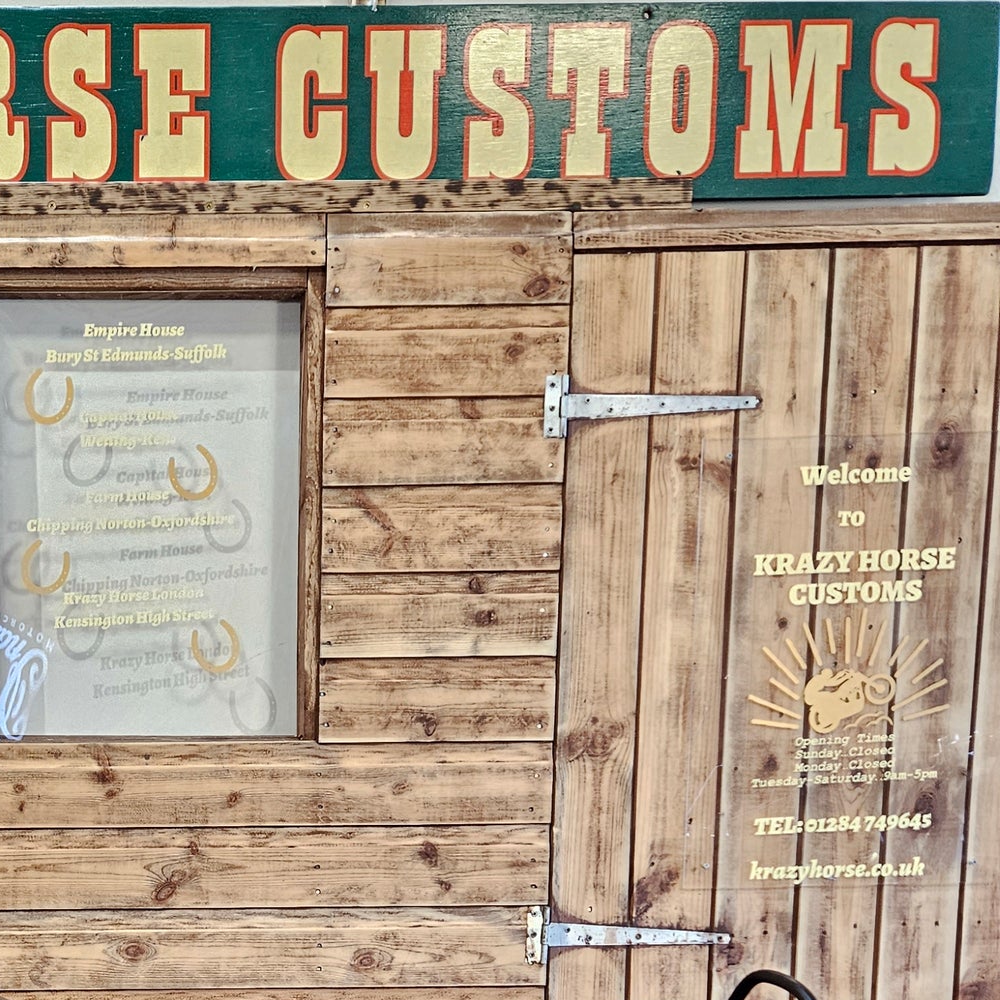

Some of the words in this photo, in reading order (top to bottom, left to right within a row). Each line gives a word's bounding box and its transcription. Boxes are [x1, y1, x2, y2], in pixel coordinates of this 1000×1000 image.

[276, 18, 940, 180] CUSTOMS
[83, 322, 137, 340] Empire
[139, 323, 185, 337] House
[45, 349, 80, 366] Bury
[83, 348, 99, 362] St
[101, 344, 227, 363] Edmunds-Suffolk
[800, 462, 912, 486] Welcome
[26, 518, 93, 535] Chipping
[838, 510, 865, 527] TO
[753, 551, 855, 576] KRAZY
[857, 547, 957, 572] HORSE
[63, 591, 107, 607] Krazy
[109, 588, 150, 603] Horse
[152, 586, 205, 601] London
[788, 579, 923, 605] CUSTOMS
[54, 613, 134, 631] Kensington
[135, 611, 170, 627] High
[171, 608, 214, 622] Street
[795, 735, 850, 748] Opening
[857, 733, 896, 743] Times
[863, 813, 932, 832] 749645
[749, 857, 925, 885] krazyhorse.co.uk
